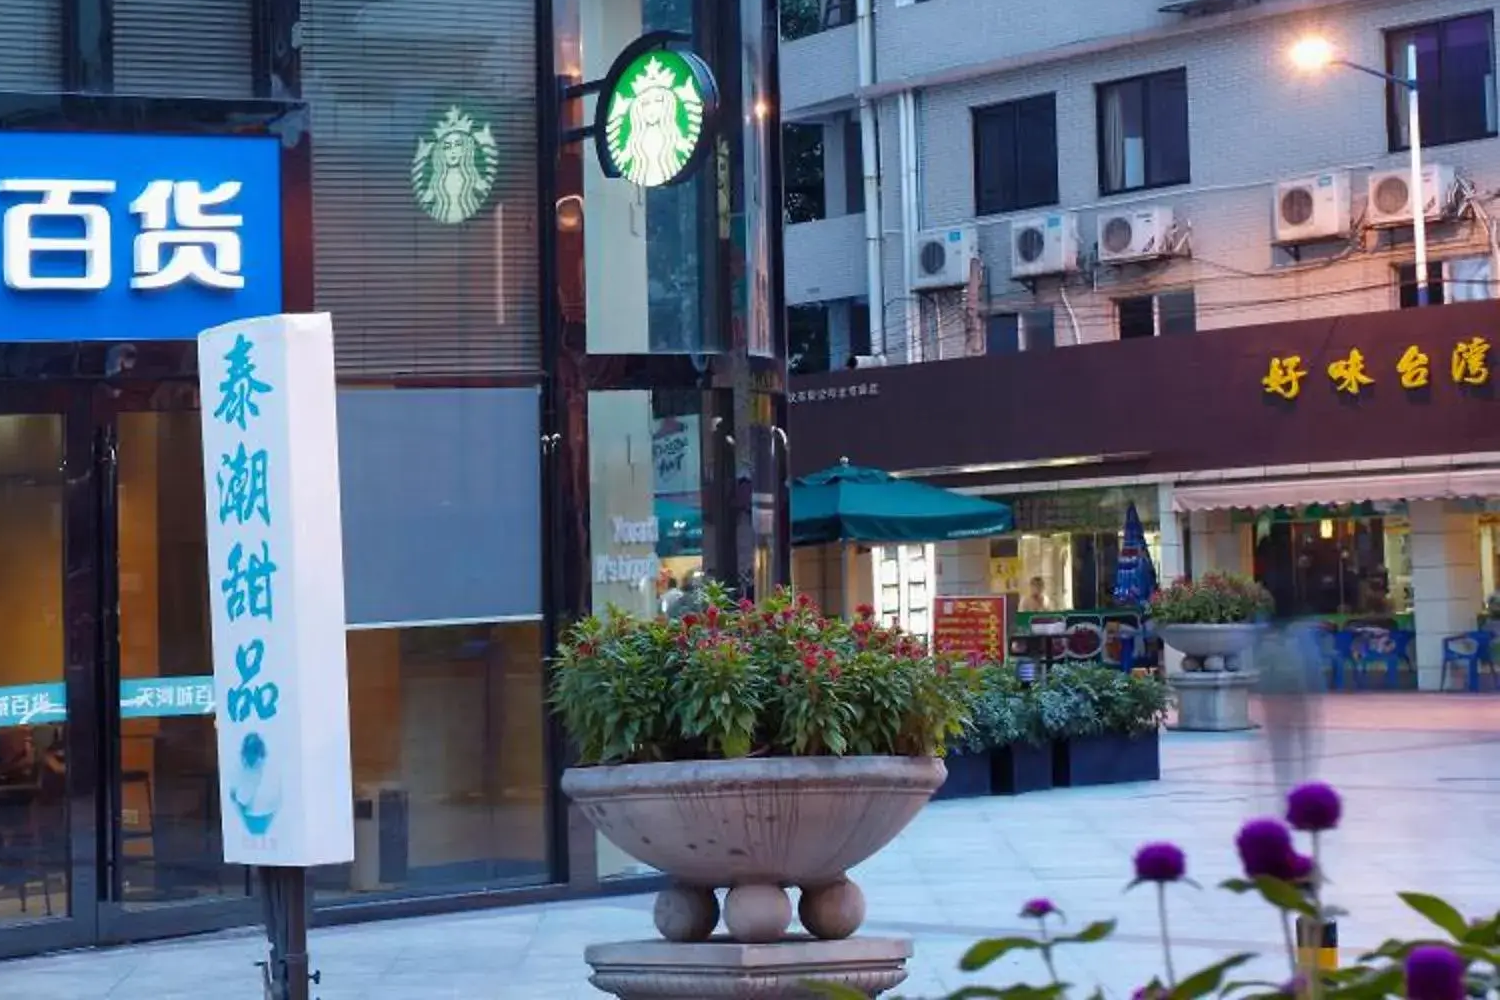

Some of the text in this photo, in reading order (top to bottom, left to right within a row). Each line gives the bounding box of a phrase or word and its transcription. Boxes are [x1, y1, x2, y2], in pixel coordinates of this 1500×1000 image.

[1261, 336, 1492, 399] 好味台湾
[213, 333, 279, 723] 泰潮甜品
